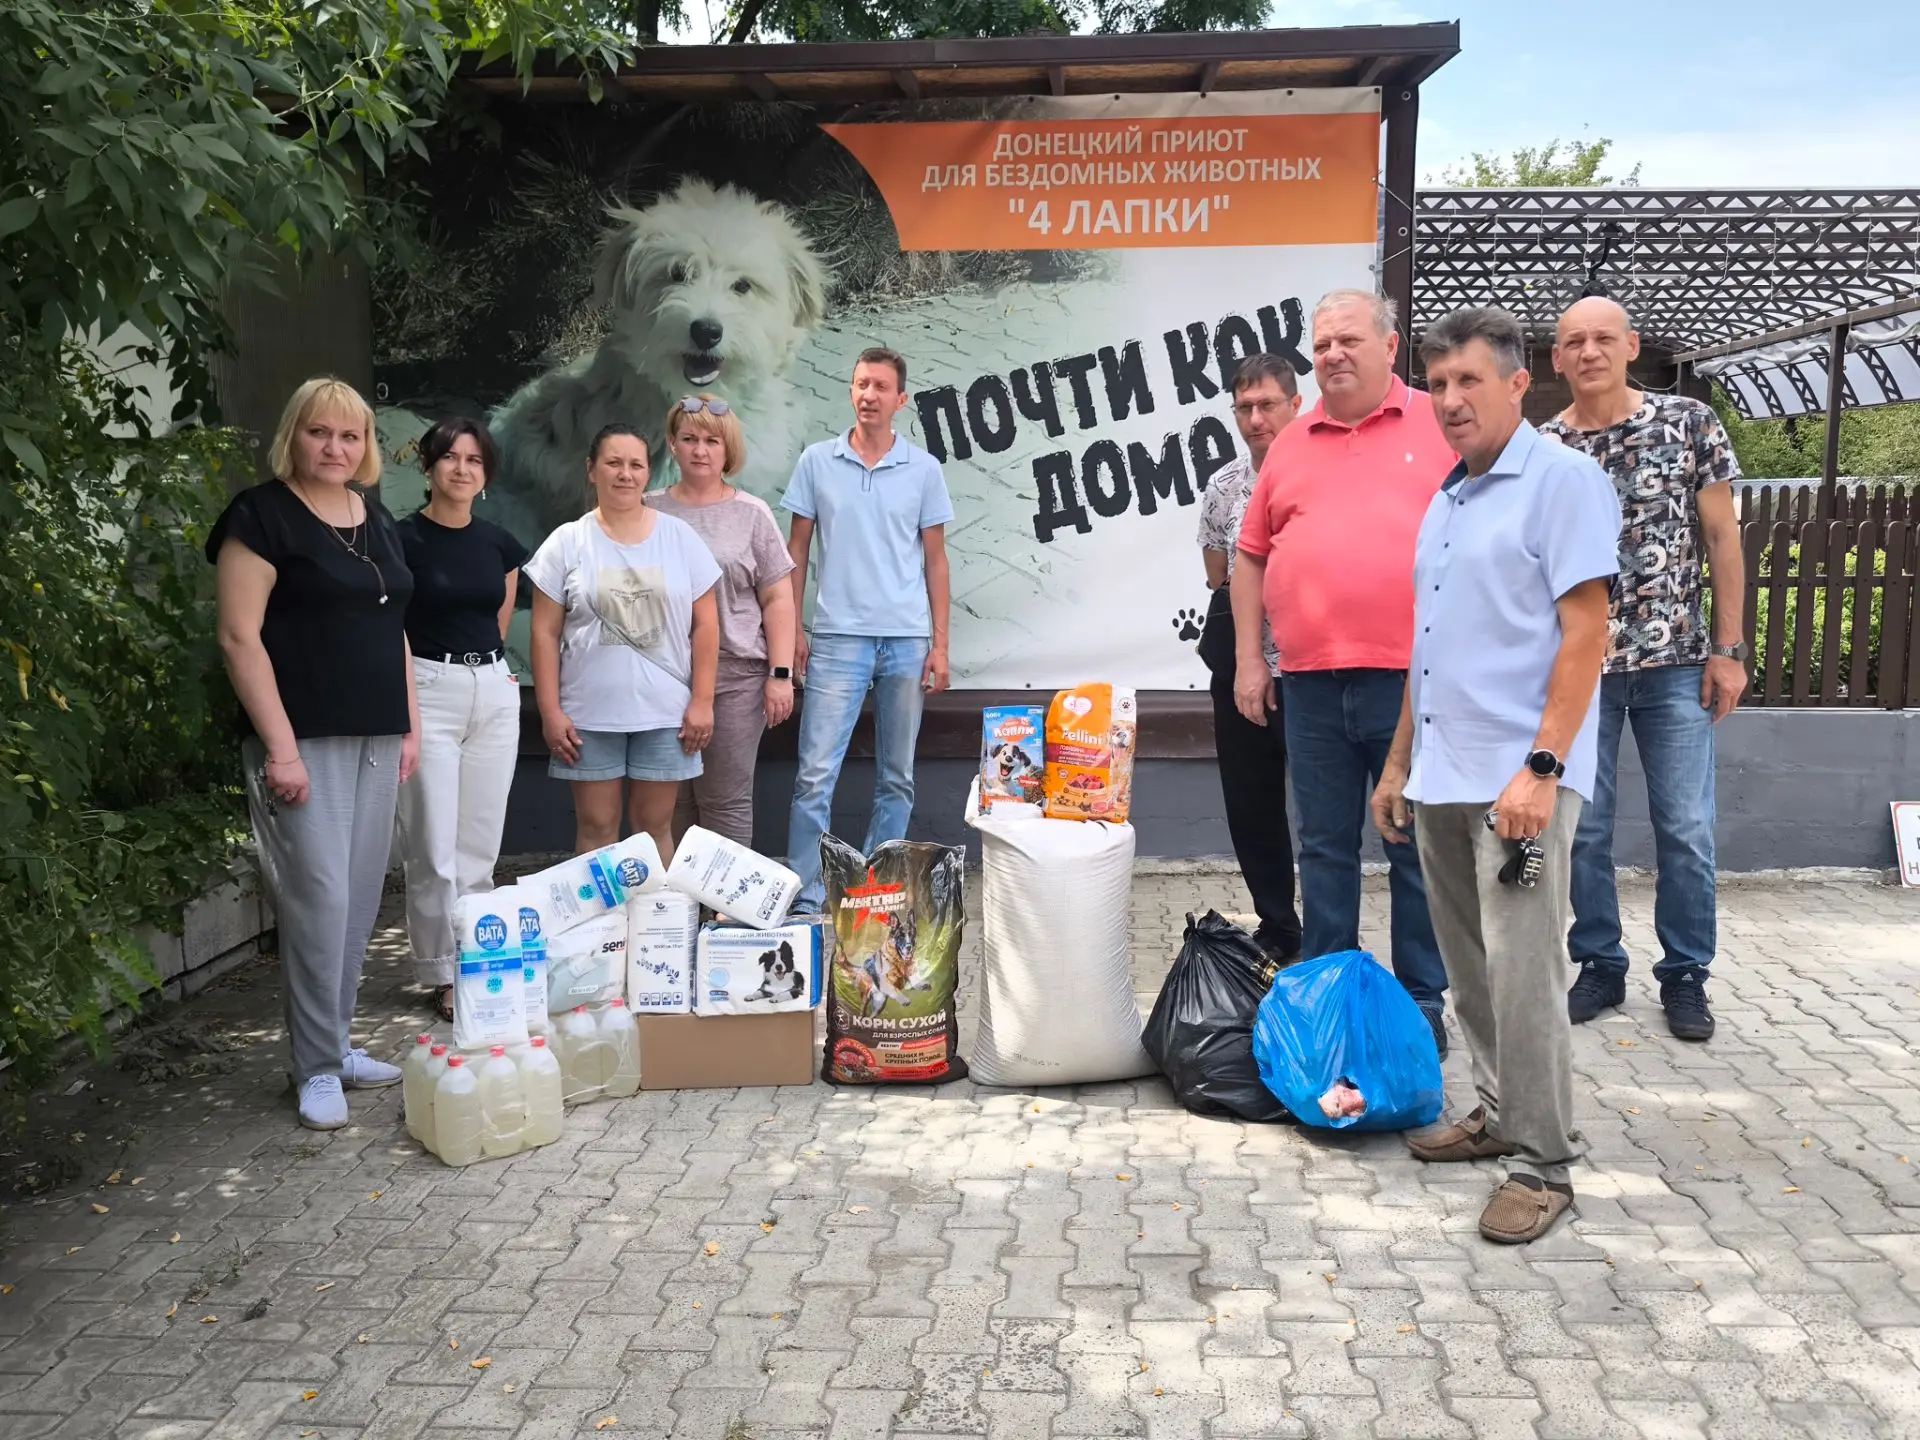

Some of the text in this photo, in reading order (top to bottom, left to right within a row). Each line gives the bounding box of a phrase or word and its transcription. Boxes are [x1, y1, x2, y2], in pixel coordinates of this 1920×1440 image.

[993, 126, 1249, 160] ДОНЕЦКИЙ ПРИЮТ
[921, 157, 1323, 193] ДЛЯ БЕЗДОМНЫХ ЖИВОТНЫХ
[1008, 194, 1230, 235] "4 ЛАПКИ"
[913, 297, 1314, 464] ПОЧТИ КАК
[1032, 414, 1238, 544] ДОМА
[477, 924, 505, 942] ВАТА
[519, 917, 540, 933] АТА
[852, 1007, 947, 1030] КОРМ СУХОЙ
[872, 1031, 889, 1039] ДЛЯ
